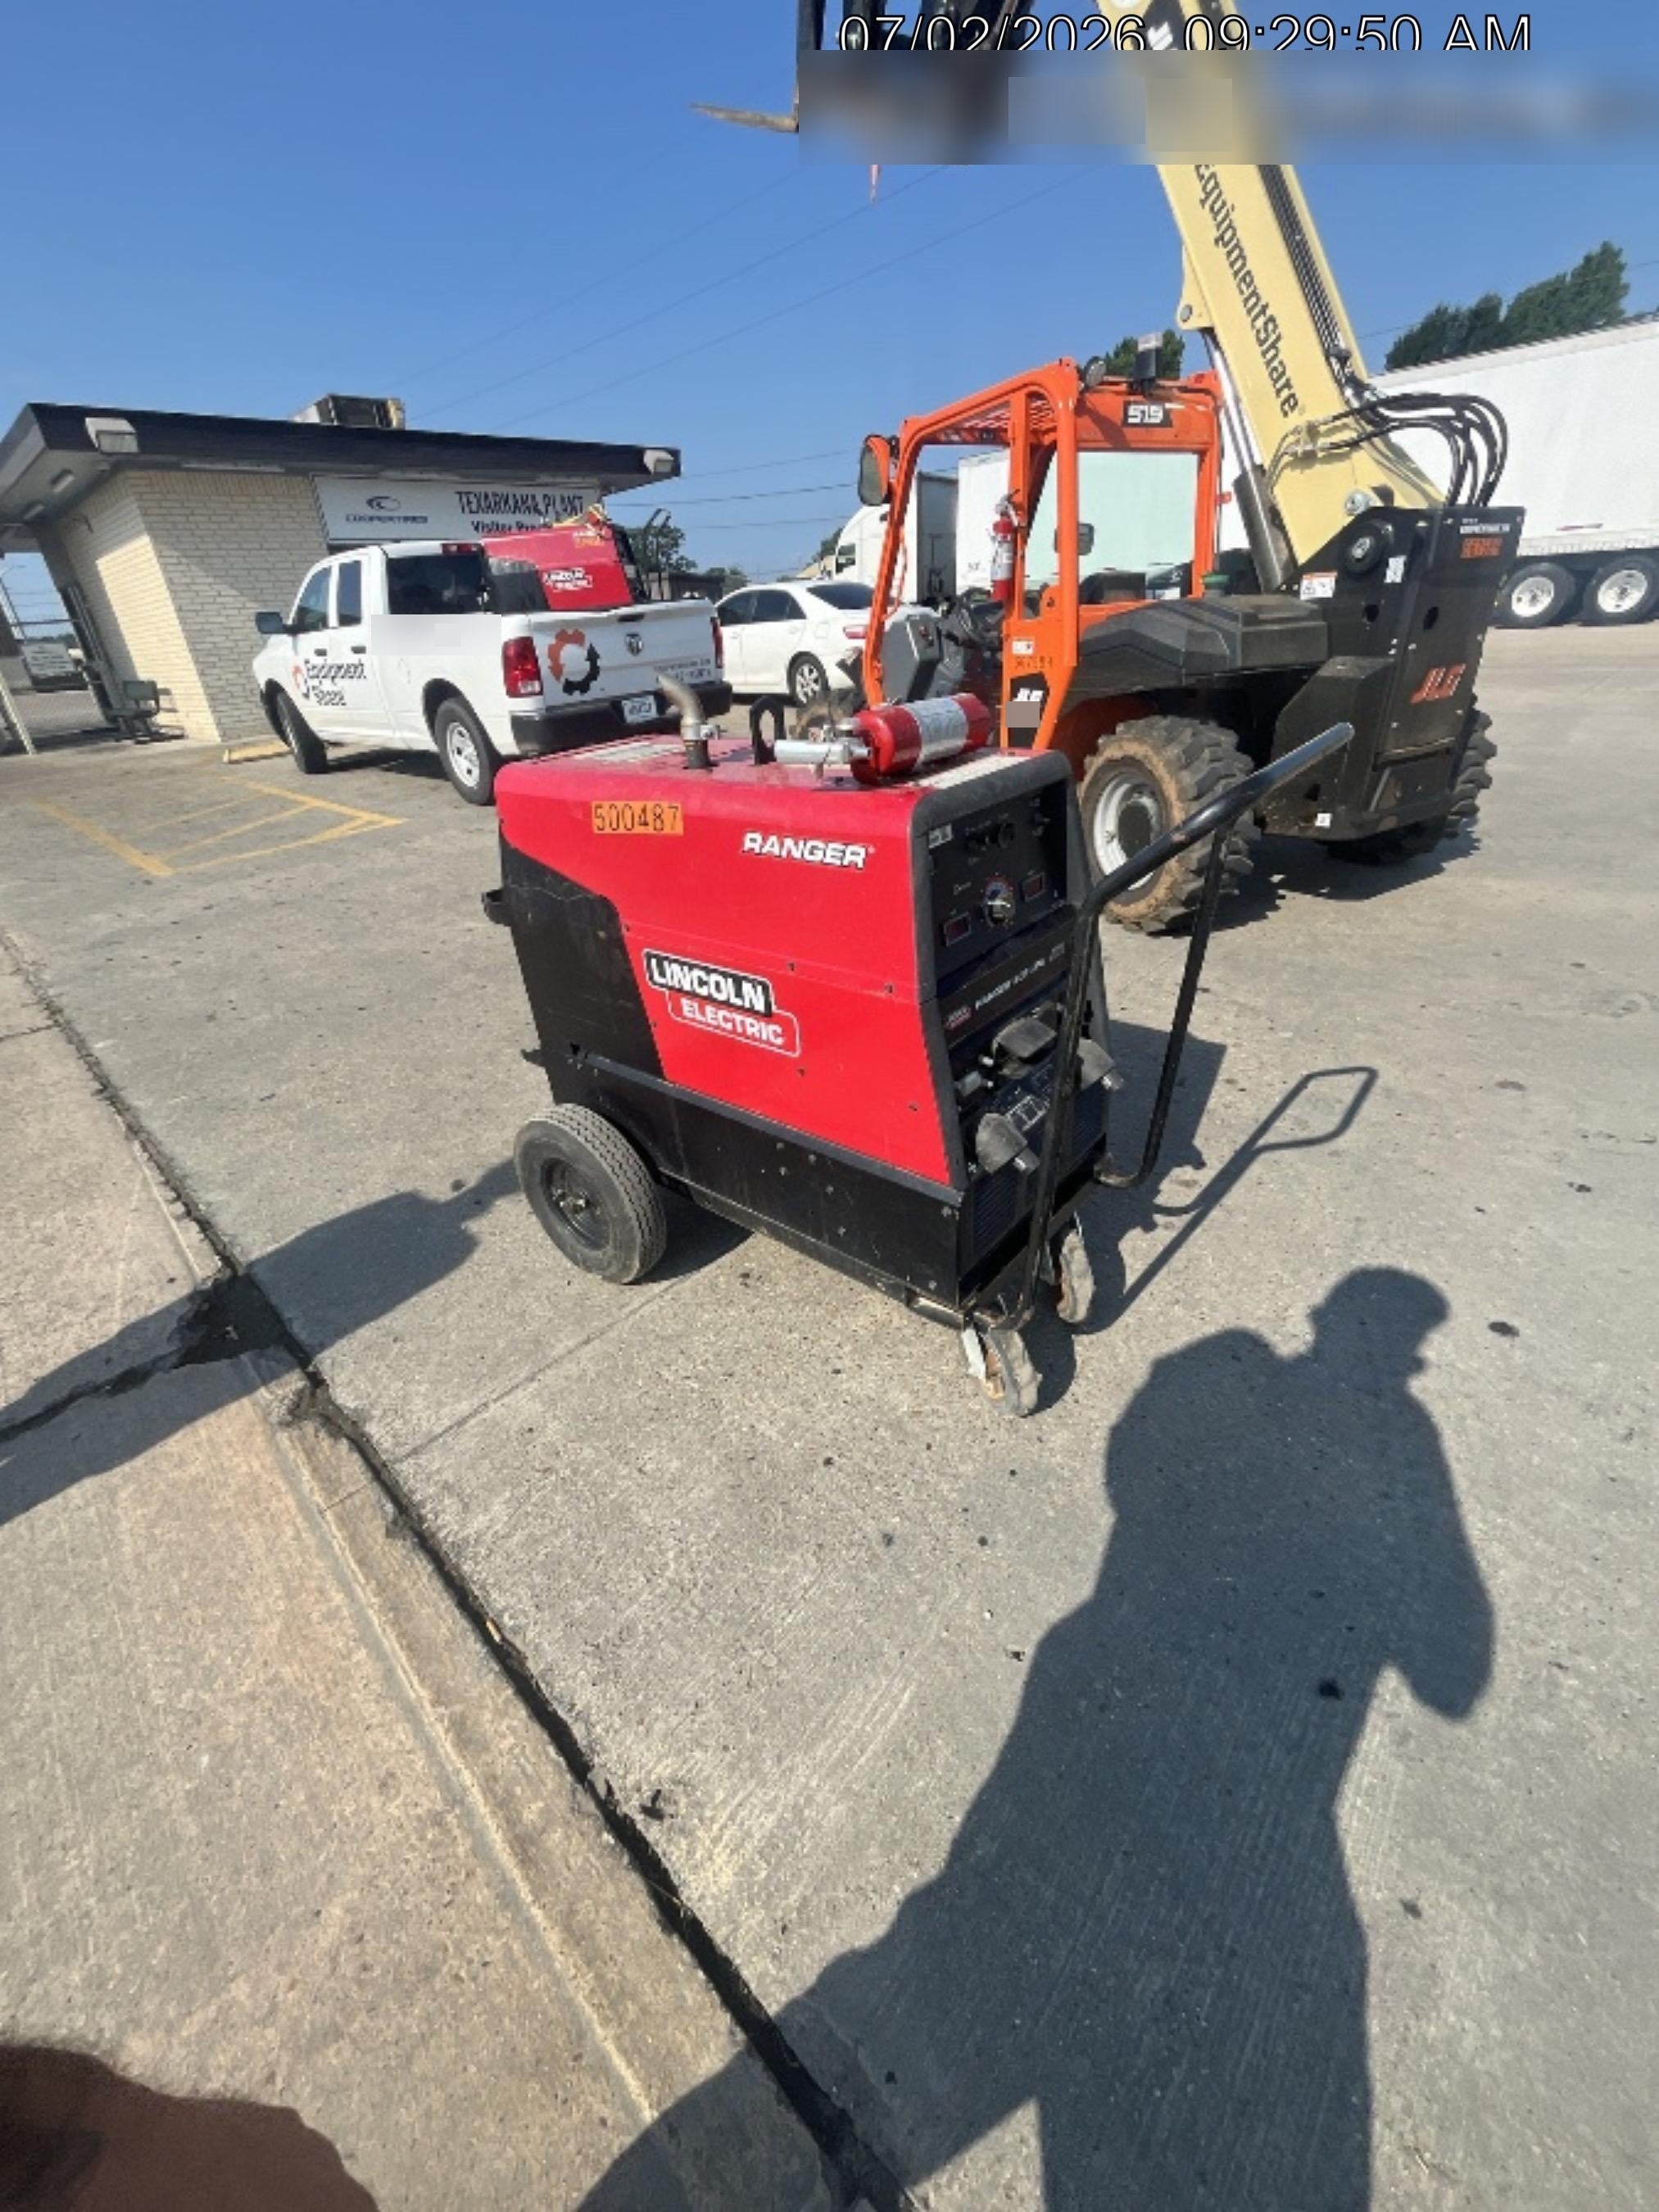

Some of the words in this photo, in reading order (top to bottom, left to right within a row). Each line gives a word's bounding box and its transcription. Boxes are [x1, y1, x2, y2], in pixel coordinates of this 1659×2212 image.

[1410, 663, 1466, 705] JLG
[593, 803, 680, 832] 500487
[742, 831, 867, 868] RANGER
[650, 957, 766, 1013] LINCOLN
[680, 996, 784, 1045] ELECTRIC
